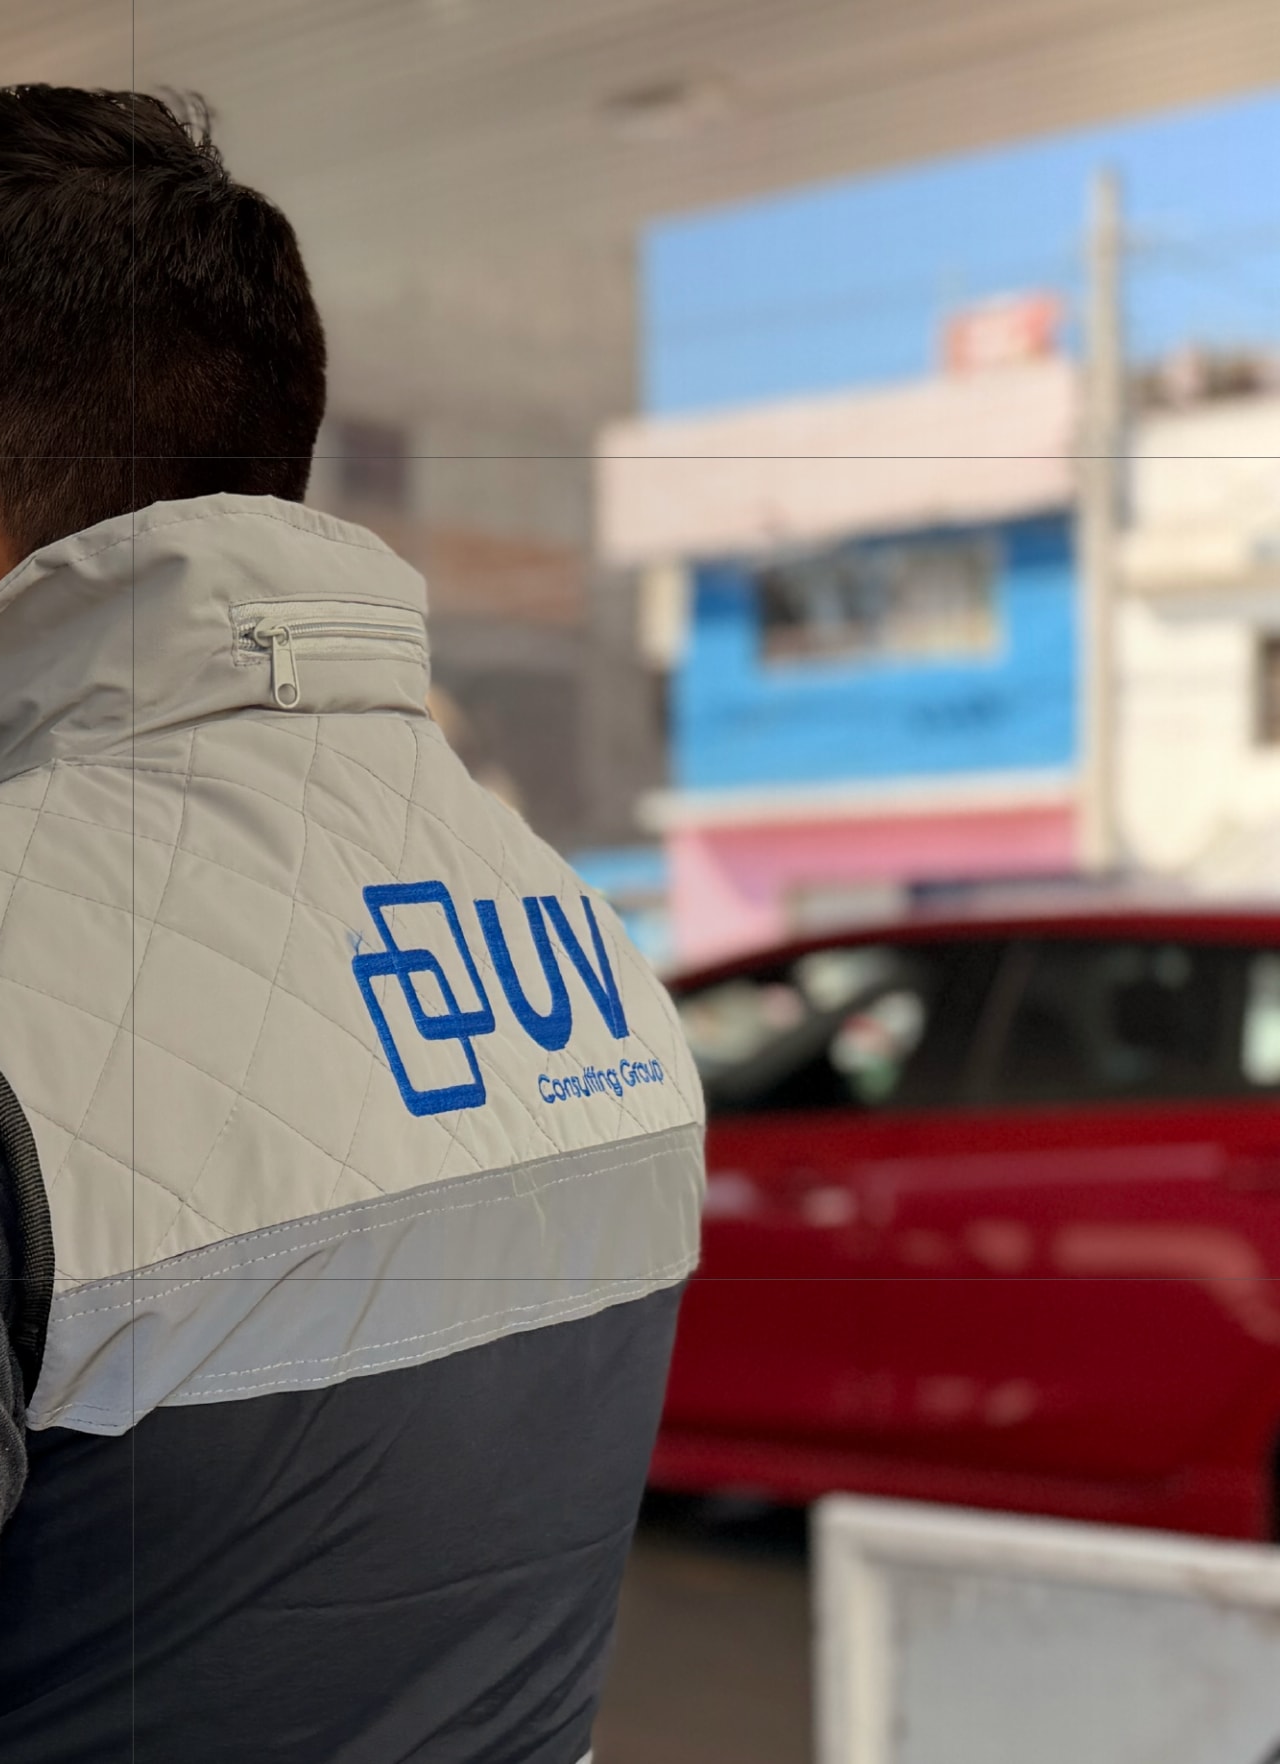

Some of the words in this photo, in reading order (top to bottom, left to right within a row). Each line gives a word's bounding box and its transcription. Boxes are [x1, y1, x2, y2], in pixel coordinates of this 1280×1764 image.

[473, 895, 630, 1052] UV
[538, 1065, 623, 1104] Consulting
[620, 1058, 664, 1088] Group
